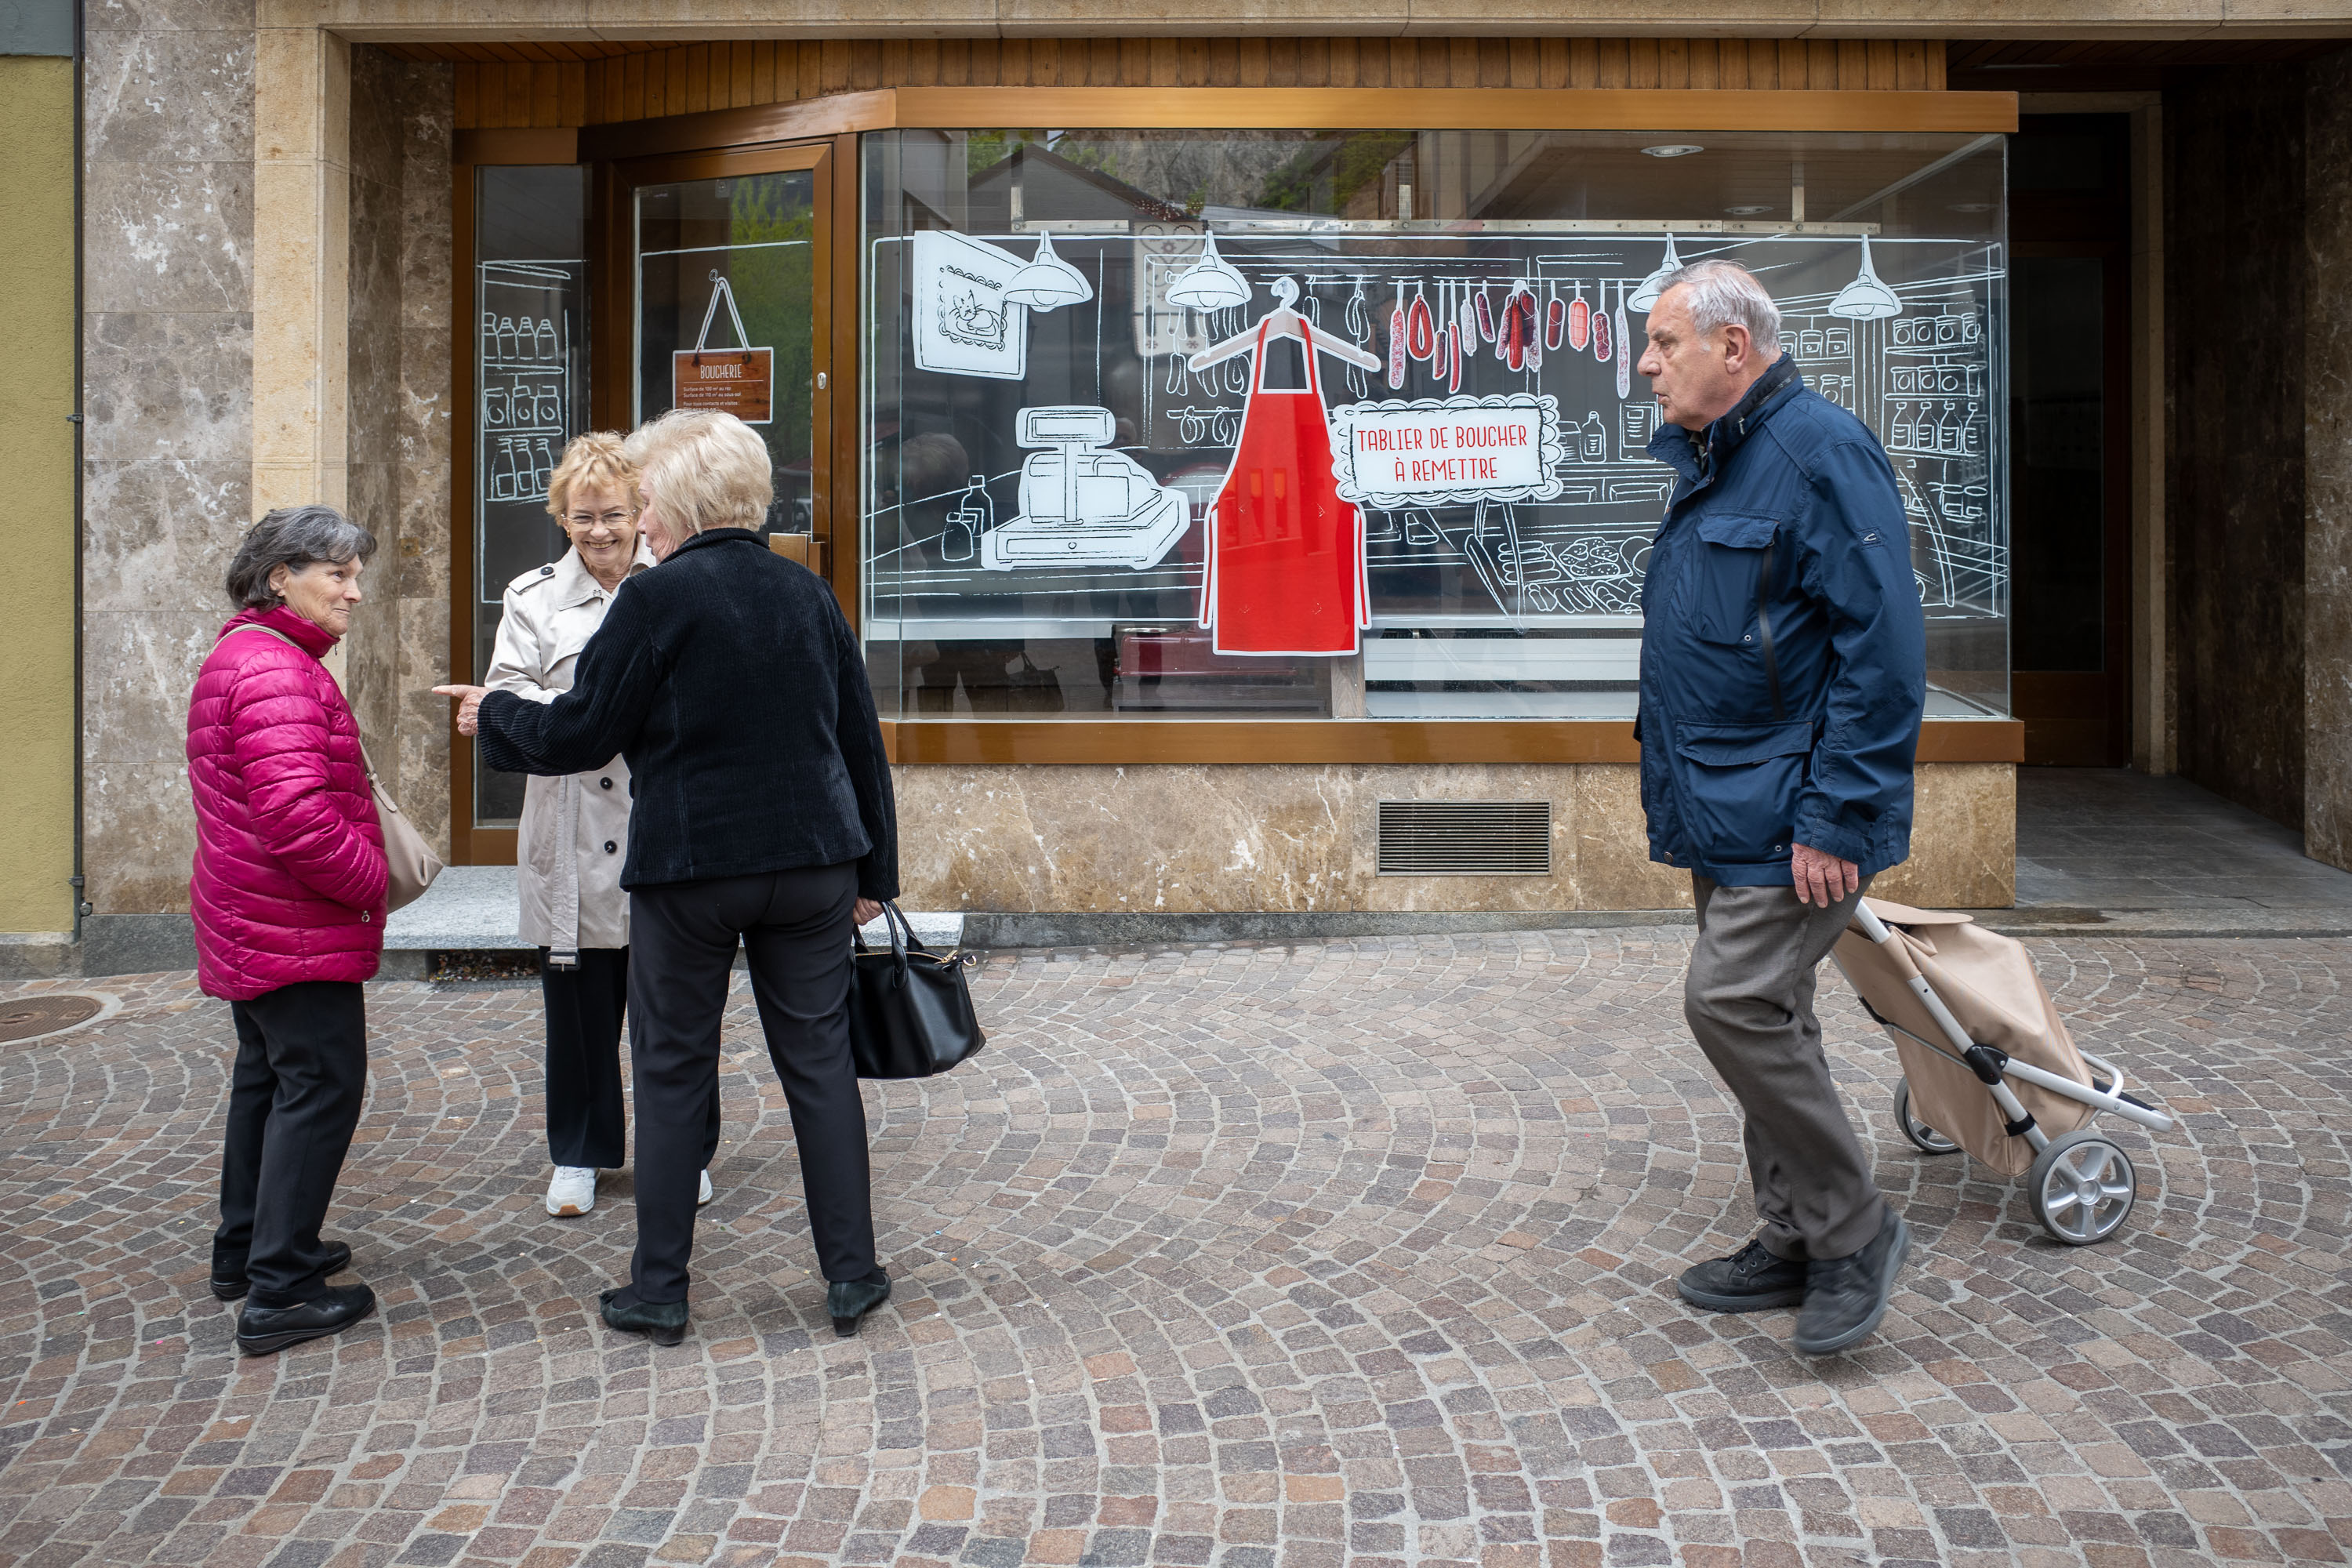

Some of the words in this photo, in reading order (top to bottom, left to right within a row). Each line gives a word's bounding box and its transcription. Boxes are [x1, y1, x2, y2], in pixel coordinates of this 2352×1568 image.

[700, 364, 742, 379] BOUCHERIE
[1357, 428, 1423, 452] TABLIER
[1430, 427, 1448, 449] DE
[1456, 425, 1527, 448] BOUCHER
[1396, 457, 1406, 482] À
[1412, 457, 1497, 481] REMETTRE
